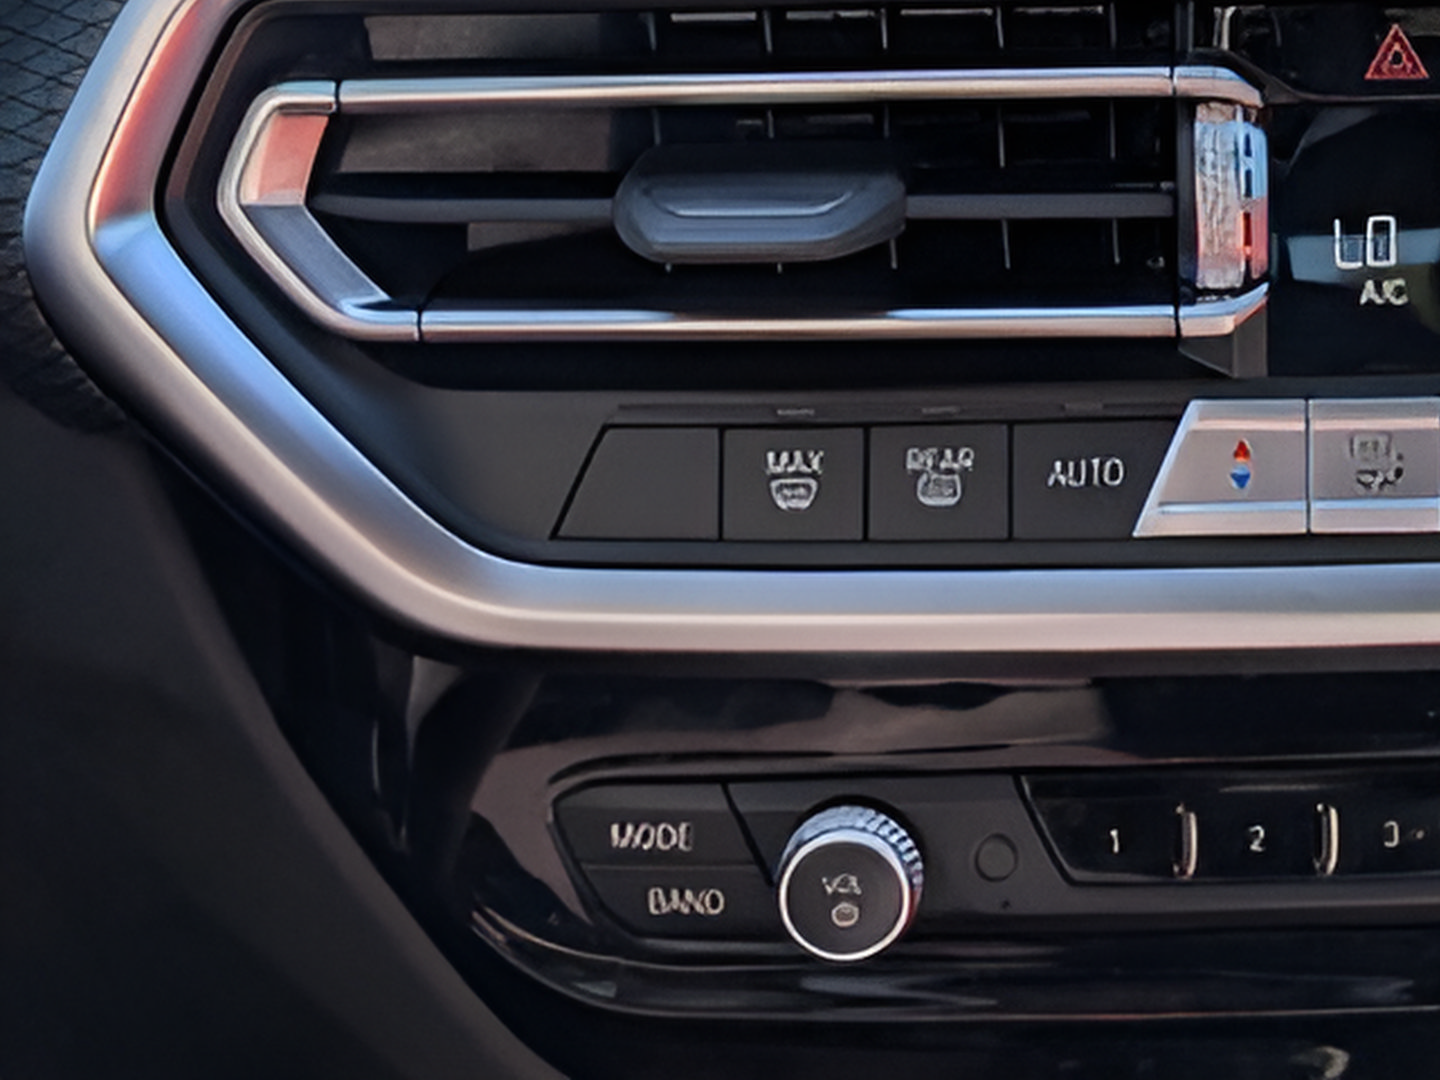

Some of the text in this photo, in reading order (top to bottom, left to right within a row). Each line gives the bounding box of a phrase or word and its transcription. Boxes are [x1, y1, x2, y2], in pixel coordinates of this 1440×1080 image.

[1046, 456, 1125, 488] AUTO
[1109, 829, 1120, 853] 1
[1249, 824, 1266, 852] 2
